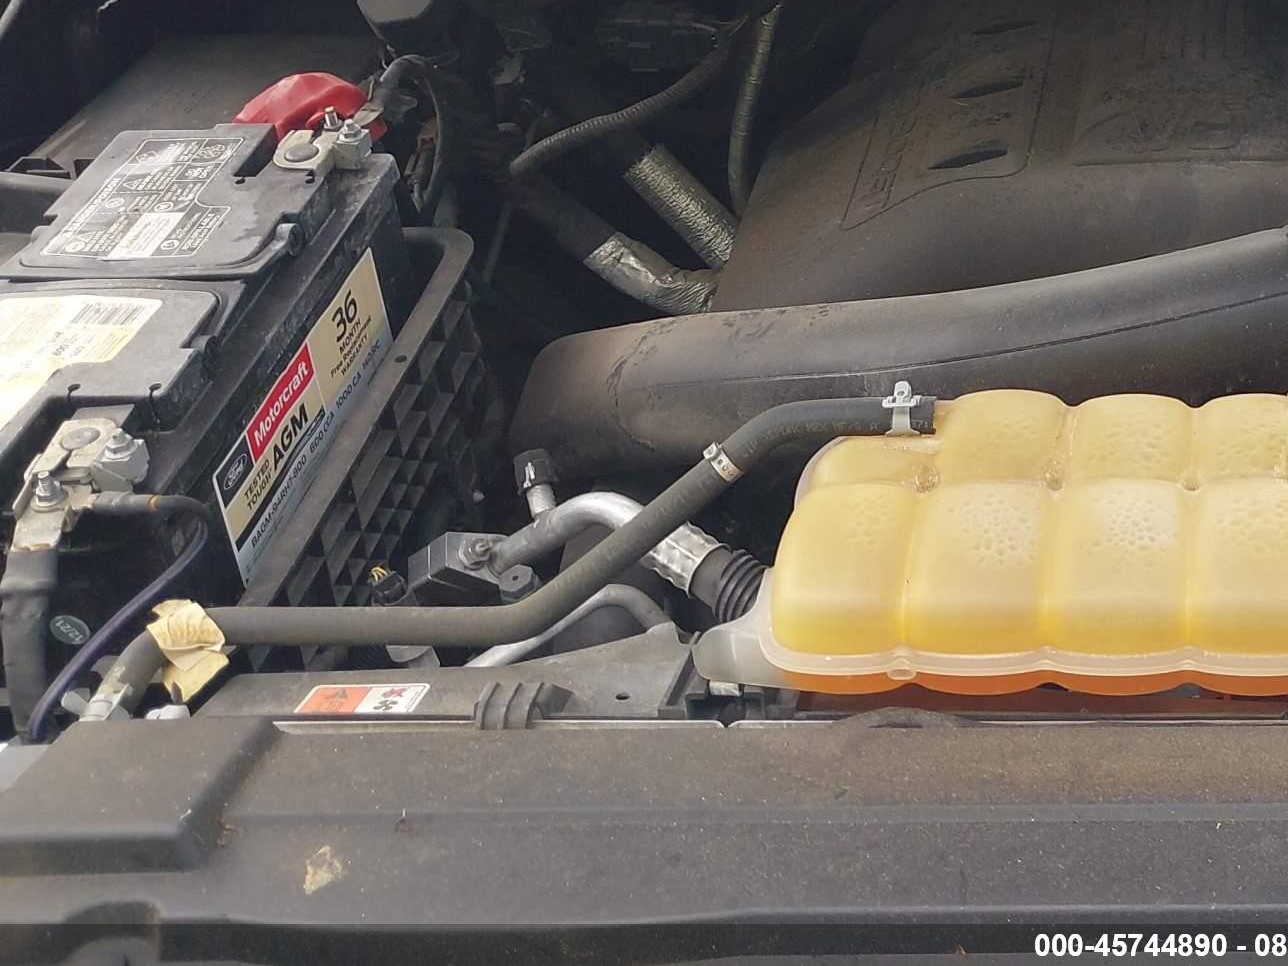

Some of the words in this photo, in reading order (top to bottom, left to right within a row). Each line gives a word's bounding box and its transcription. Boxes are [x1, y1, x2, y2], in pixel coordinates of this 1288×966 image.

[331, 289, 358, 344] 36
[339, 318, 361, 355] MONTH
[330, 355, 345, 379] Free
[343, 314, 372, 362] Replacement
[341, 332, 368, 377] WARRANTY
[253, 361, 309, 448] Motorcraft
[271, 403, 309, 472] AGM
[244, 460, 269, 501] TESTED
[247, 473, 272, 511] TOUGH
